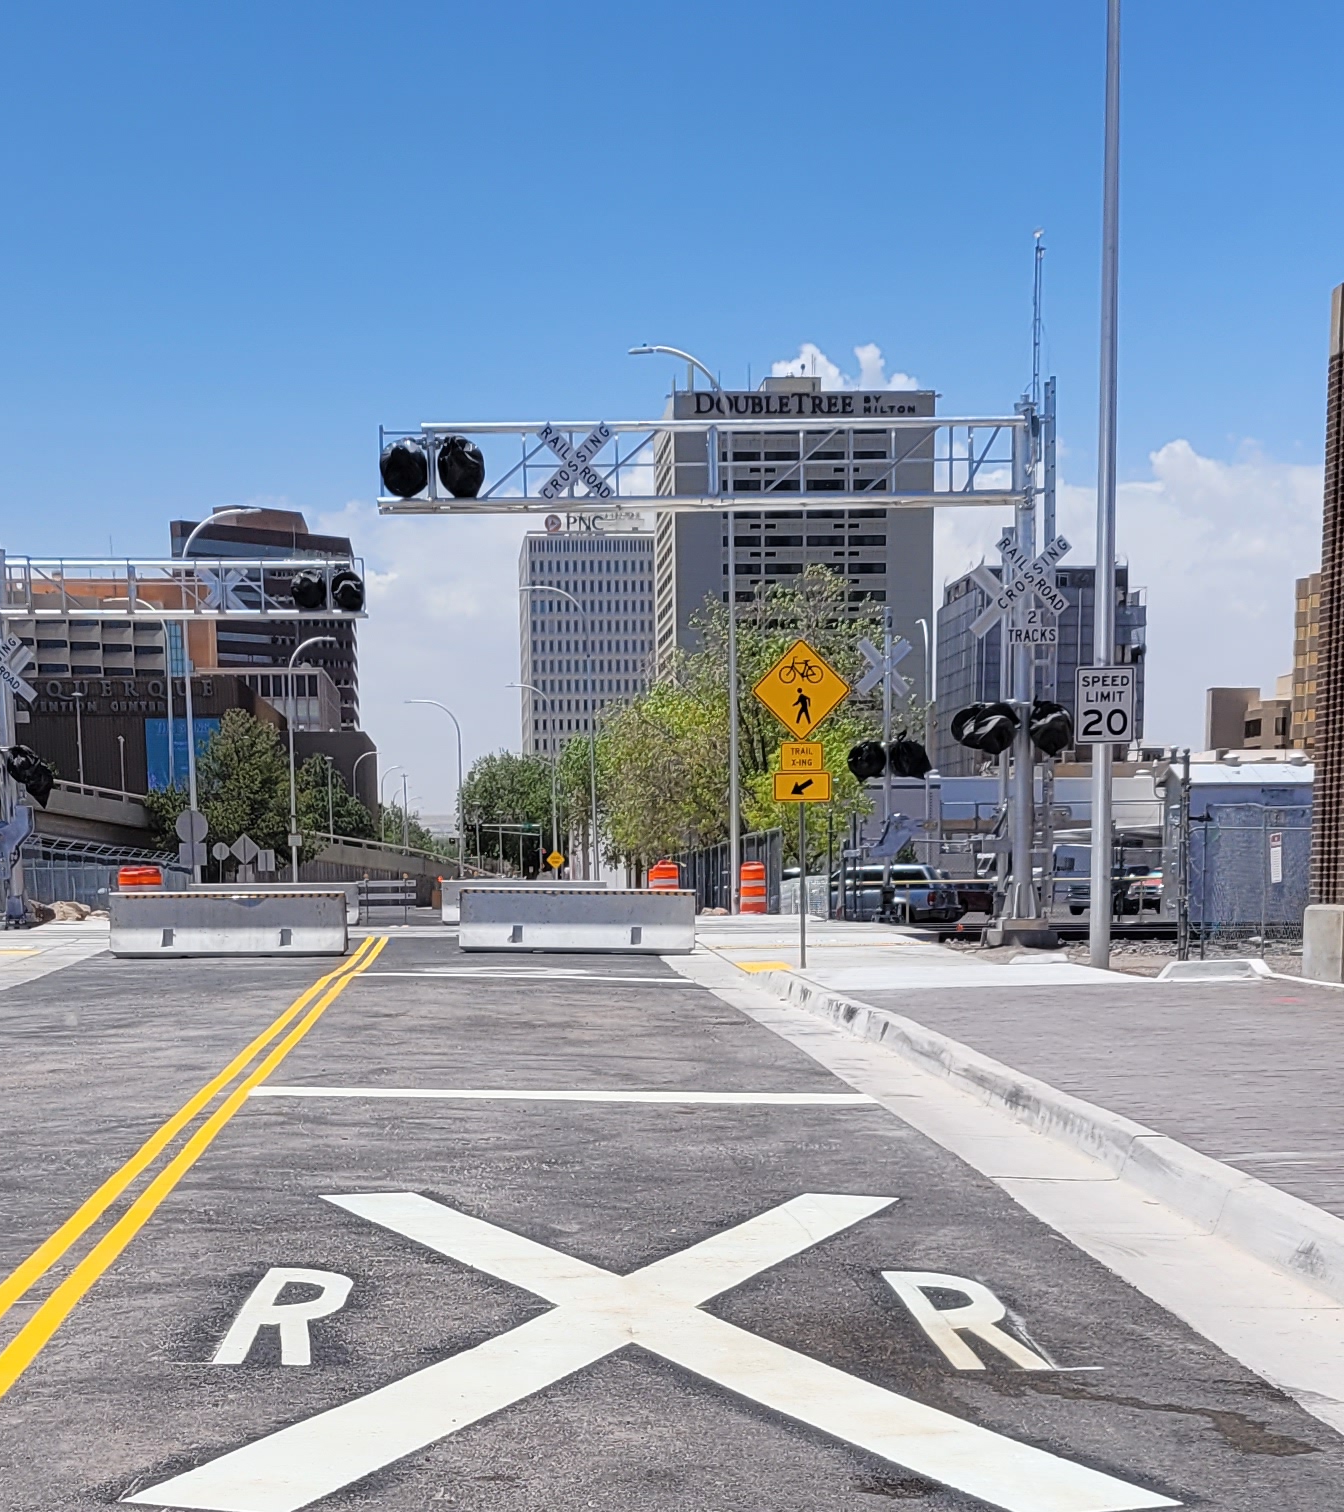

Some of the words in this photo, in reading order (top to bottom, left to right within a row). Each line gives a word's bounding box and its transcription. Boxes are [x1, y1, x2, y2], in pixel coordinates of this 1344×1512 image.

[694, 392, 855, 415] DOUBLETREE
[863, 395, 882, 404] BY
[863, 404, 916, 414] HILTON
[541, 426, 570, 460] RAIL
[579, 466, 611, 499] ROAD
[543, 425, 610, 500] CROSSING
[566, 514, 604, 531] PNC
[998, 538, 1068, 610] CROSSING
[999, 537, 1029, 571] RAIL
[1035, 578, 1065, 612] ROAD
[1027, 612, 1037, 624] 2
[1008, 628, 1056, 642] TRACKS
[1081, 675, 1130, 687] SPEED
[1086, 691, 1125, 703] LIMIT
[110, 701, 166, 713] CENTER
[1082, 708, 1128, 736] 20
[790, 747, 813, 756] TRAIL
[791, 759, 813, 767] X-ING
[212, 1267, 354, 1366] R
[881, 1270, 1055, 1371] R
